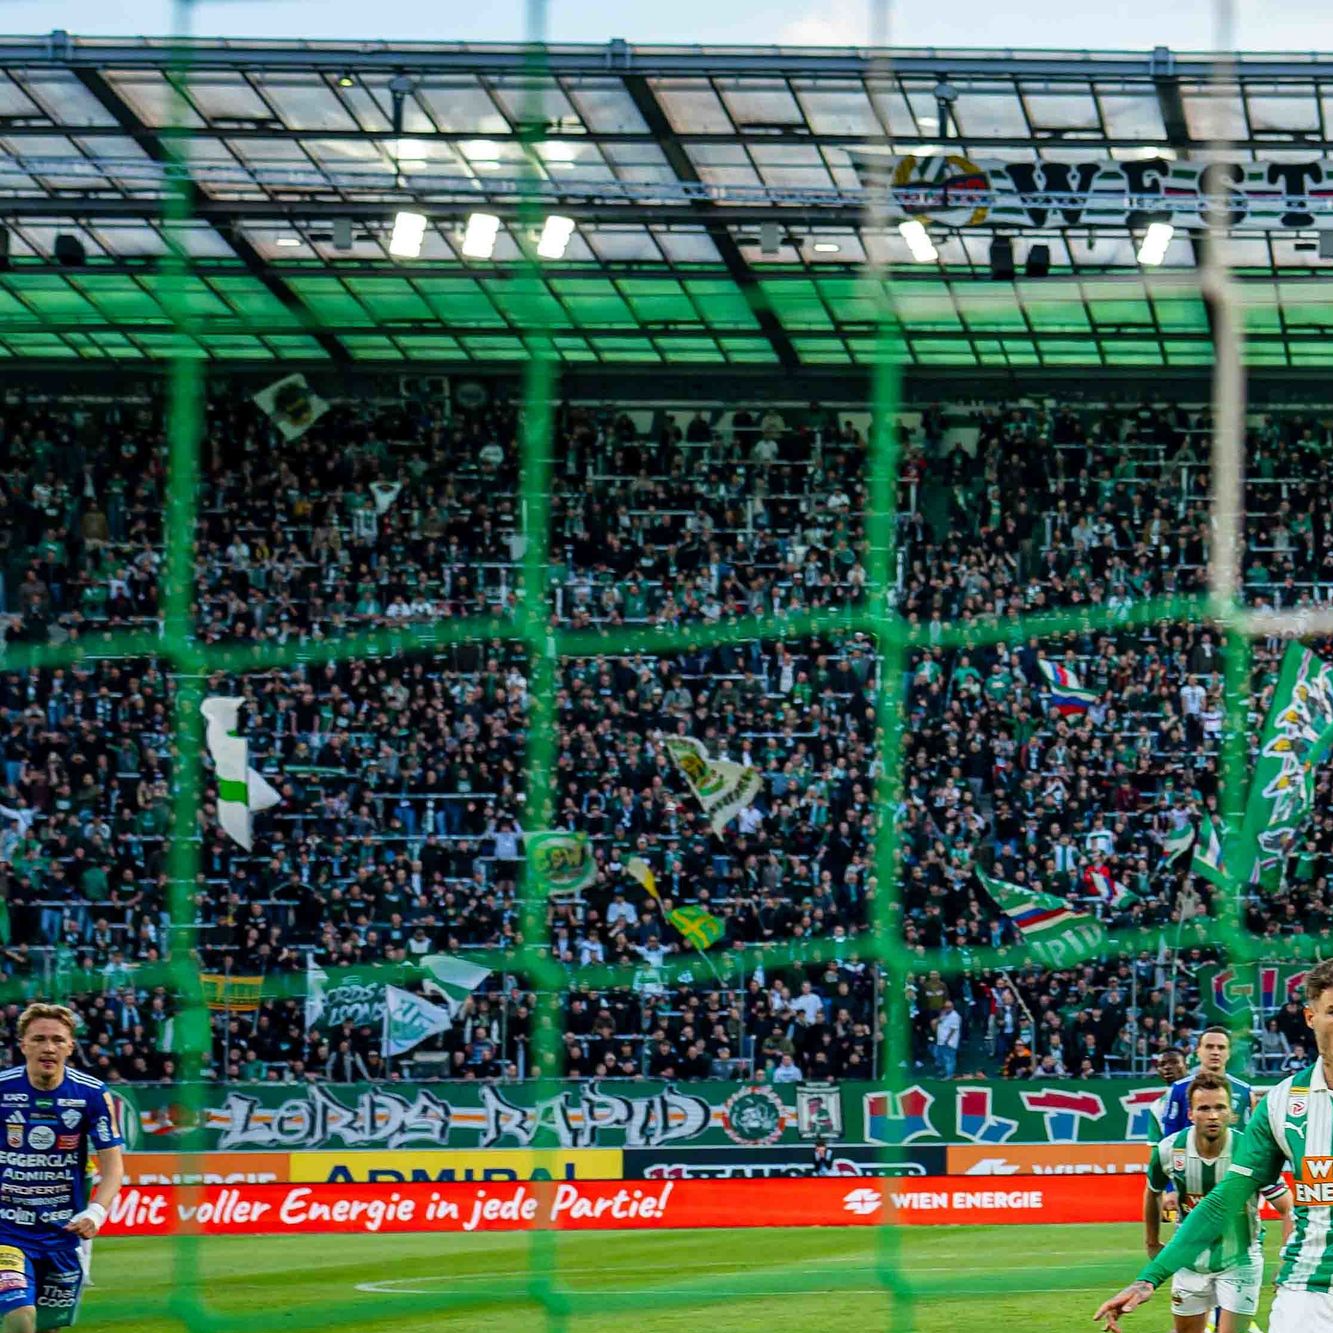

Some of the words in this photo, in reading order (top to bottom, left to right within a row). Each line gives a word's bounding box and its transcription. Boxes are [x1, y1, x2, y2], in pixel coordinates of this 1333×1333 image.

[217, 1082, 451, 1152] LORDS
[479, 1080, 712, 1150] RAPID
[3, 1168, 74, 1181] ADMIRAL
[103, 1189, 167, 1227] Mit
[176, 1188, 271, 1224] voller
[279, 1187, 415, 1231] Energie
[426, 1192, 459, 1220] in
[463, 1186, 537, 1231] jede
[550, 1181, 674, 1222] Partie!
[890, 1192, 948, 1210] WIEN
[952, 1190, 1043, 1209] ENERGIE
